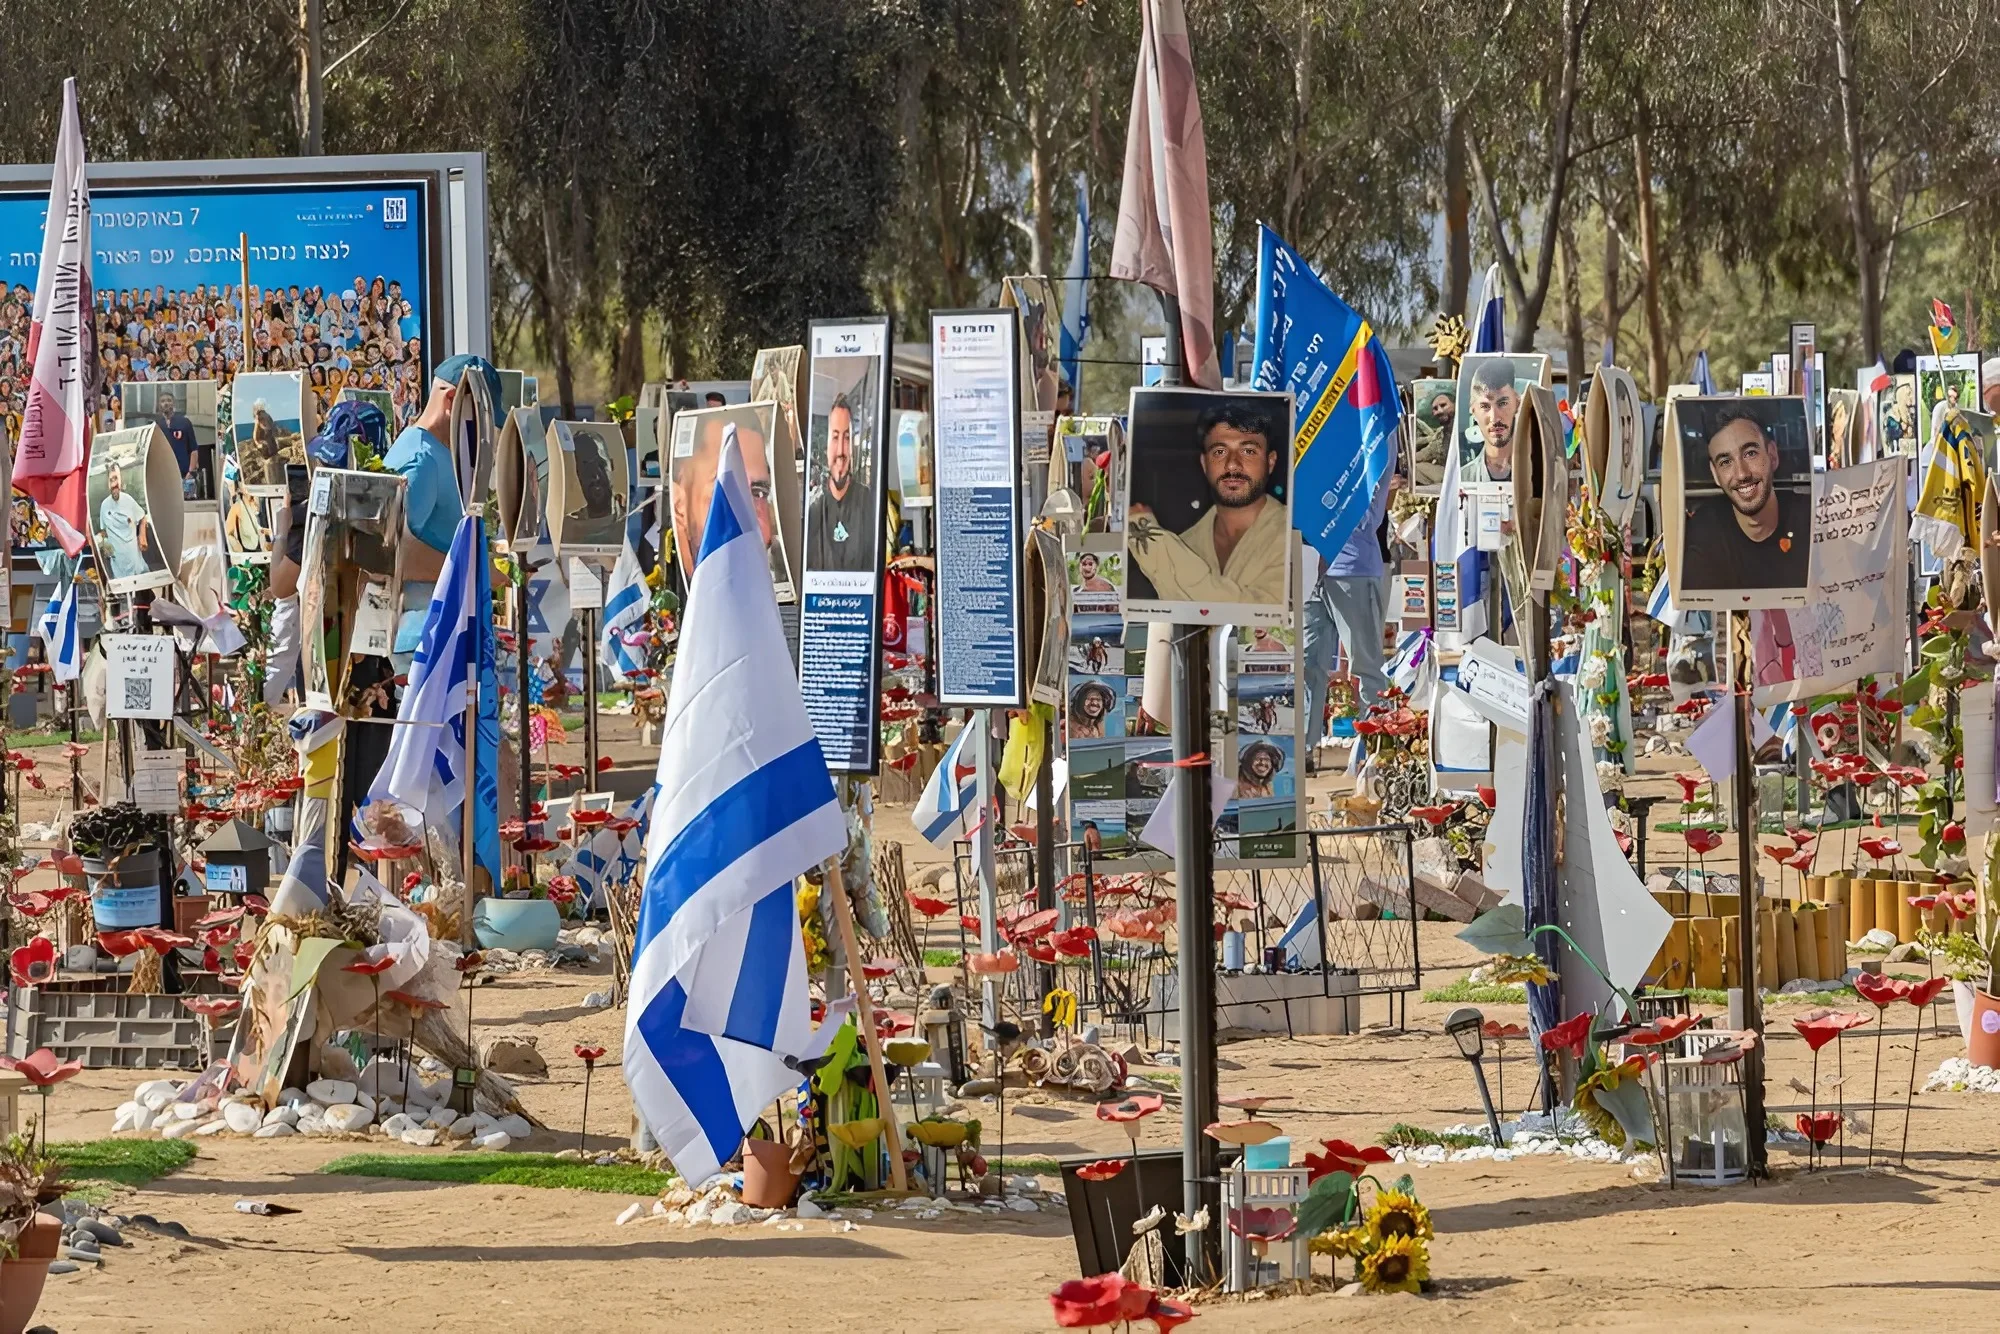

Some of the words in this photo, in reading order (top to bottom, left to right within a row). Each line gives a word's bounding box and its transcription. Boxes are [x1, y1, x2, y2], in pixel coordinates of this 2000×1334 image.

[91, 210, 183, 229] באוקטובר
[190, 207, 200, 225] 7
[150, 248, 175, 264] עם
[249, 245, 296, 261] נזכור
